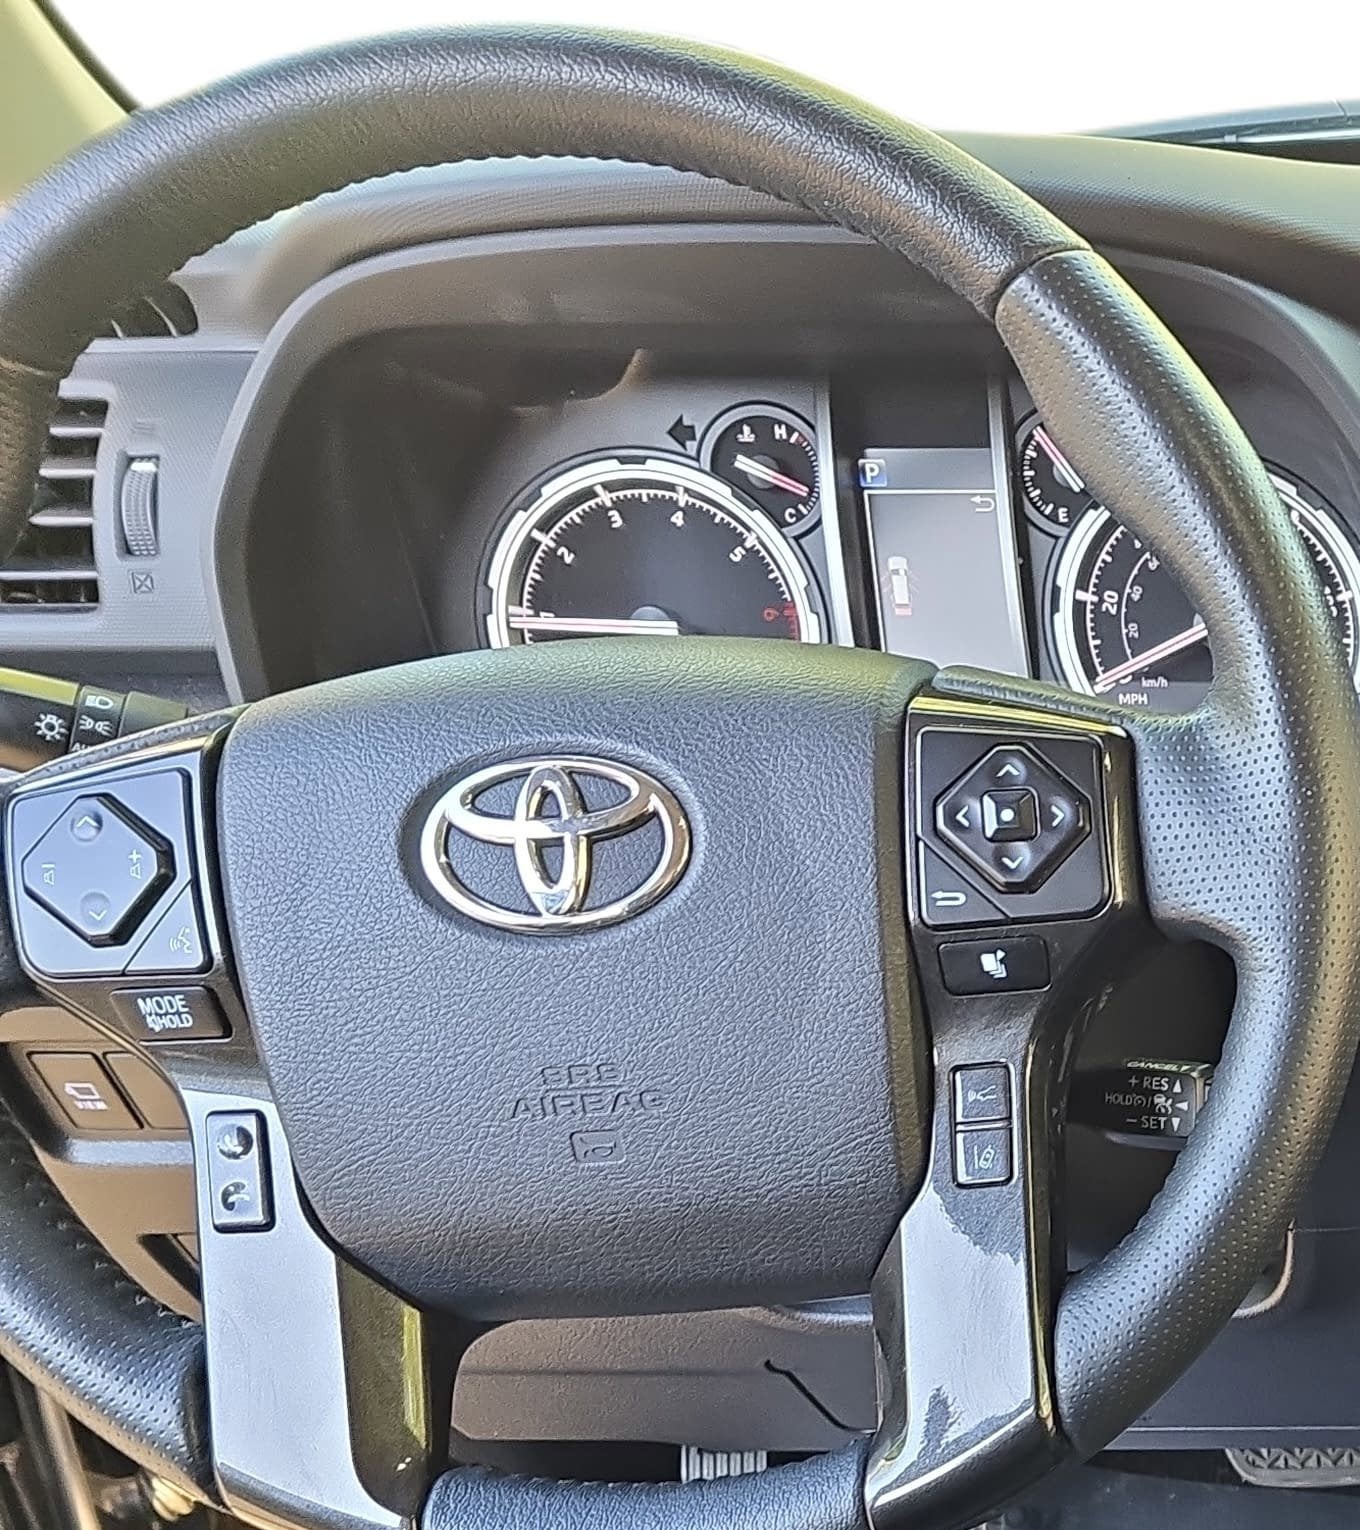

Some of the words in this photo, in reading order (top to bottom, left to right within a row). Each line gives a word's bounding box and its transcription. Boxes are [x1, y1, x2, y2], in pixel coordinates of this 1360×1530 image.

[863, 464, 880, 482] P
[606, 510, 624, 529] 3
[670, 510, 685, 527] 4
[1058, 507, 1069, 523] E
[556, 546, 576, 566] 2
[728, 546, 748, 564] 5
[1100, 590, 1120, 617] 20
[1141, 677, 1169, 688] km/h
[1118, 692, 1149, 706] MPH
[137, 994, 190, 1014] MODE
[541, 1062, 620, 1087] SRS
[1126, 1061, 1180, 1072] CANCEL
[511, 1089, 669, 1119] AIRBAG
